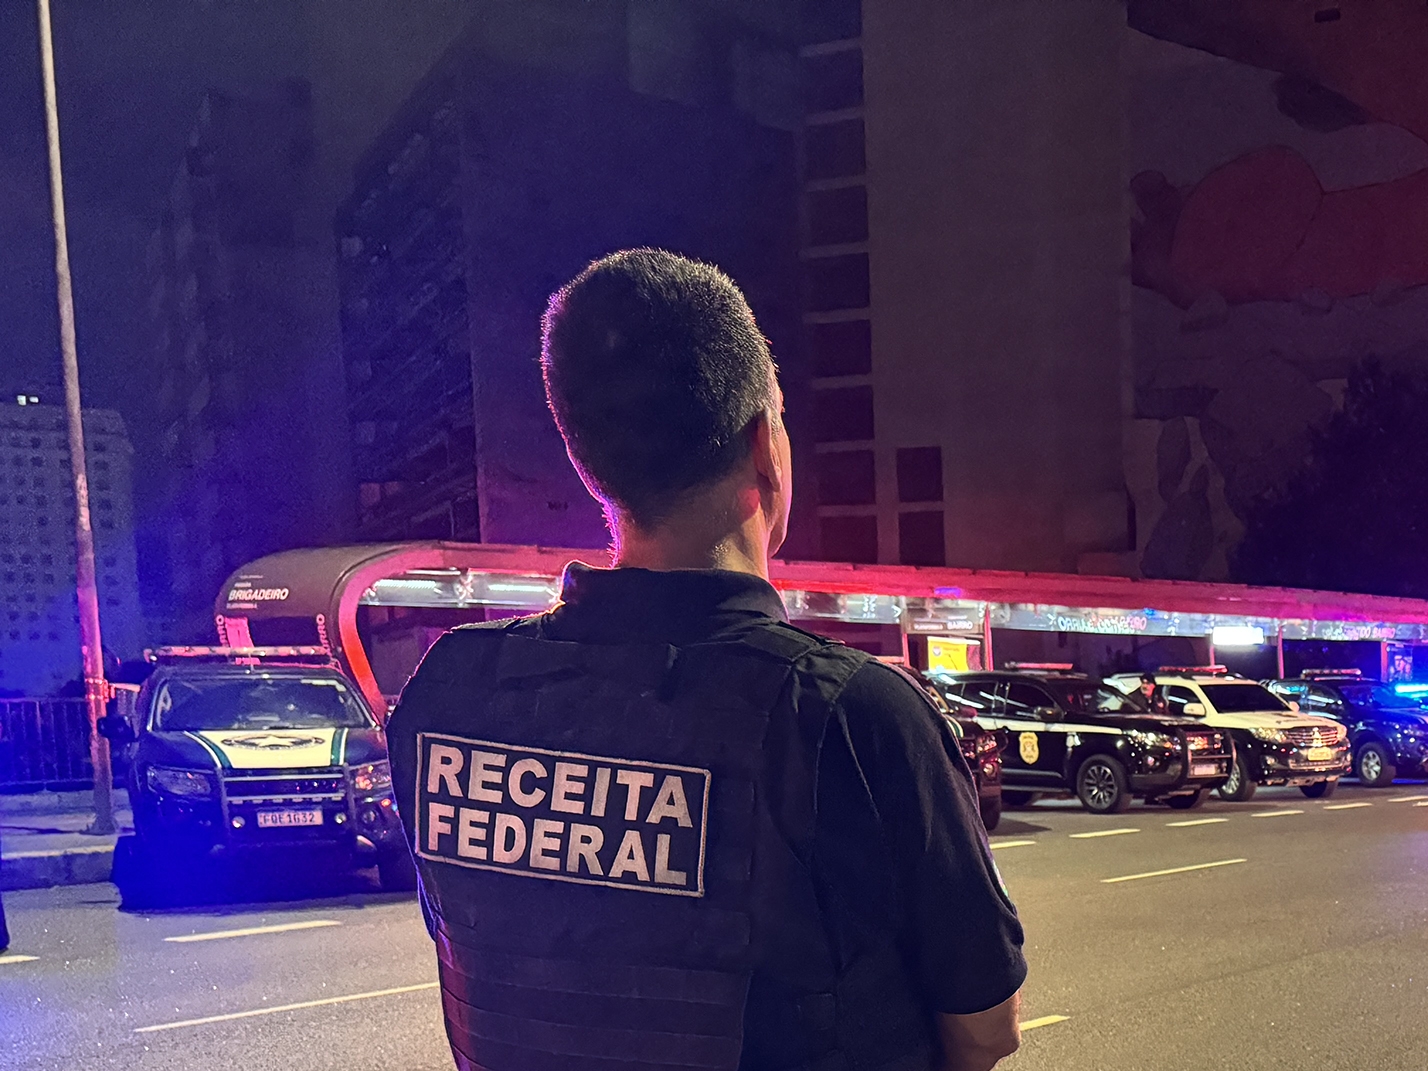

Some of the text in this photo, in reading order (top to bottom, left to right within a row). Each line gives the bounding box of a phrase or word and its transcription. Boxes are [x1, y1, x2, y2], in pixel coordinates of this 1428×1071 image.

[228, 588, 289, 601] BRIGADEIRO
[427, 744, 693, 828] RECEITA
[428, 802, 687, 886] FEDERAL
